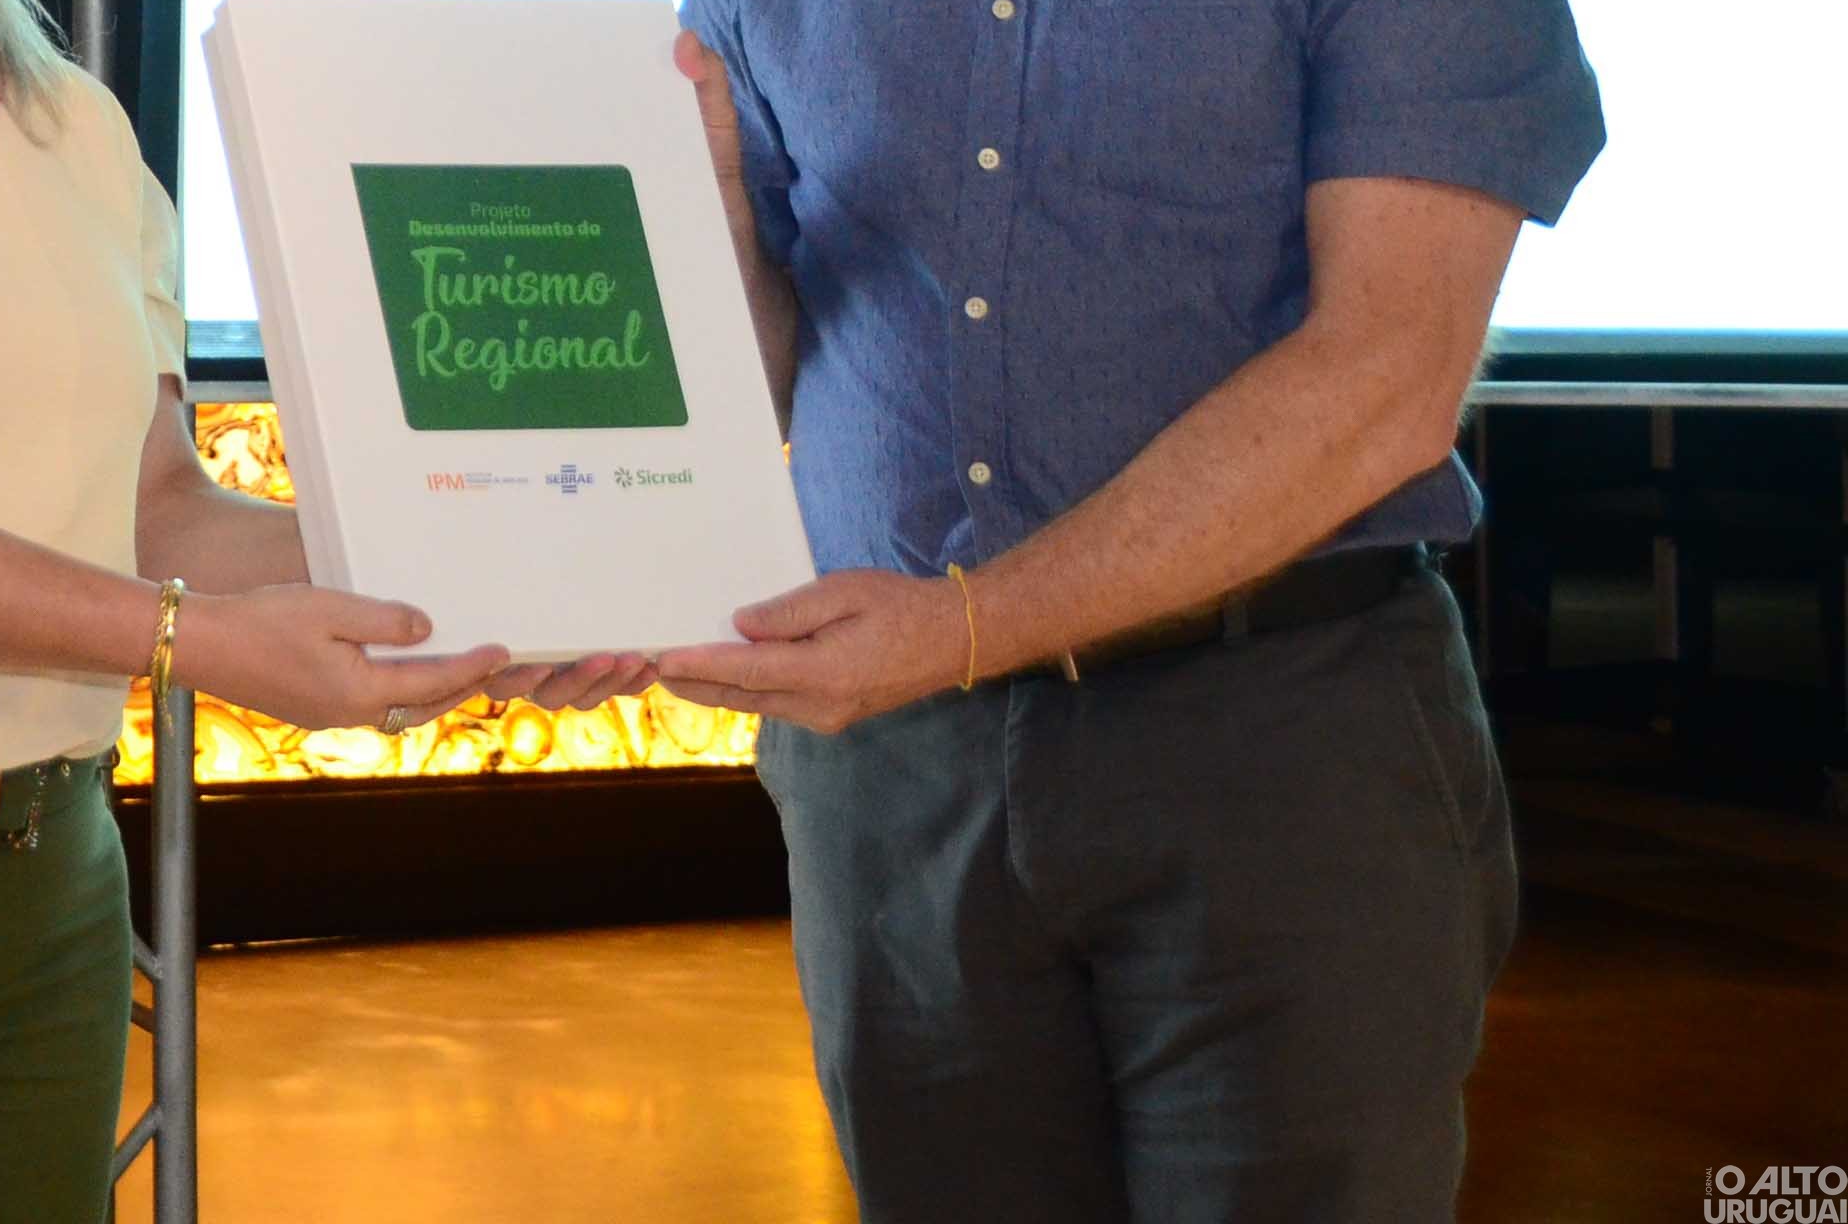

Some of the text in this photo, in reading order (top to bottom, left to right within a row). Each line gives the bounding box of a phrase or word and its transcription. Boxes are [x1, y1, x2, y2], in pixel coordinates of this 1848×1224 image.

[470, 202, 531, 222] Projeto
[408, 219, 601, 237] Desenvolvimento do
[411, 245, 616, 312] Turismo
[411, 309, 650, 391] Regional
[427, 473, 464, 491] IPM
[545, 473, 594, 485] SEBRAE
[636, 467, 693, 485] Sicredi
